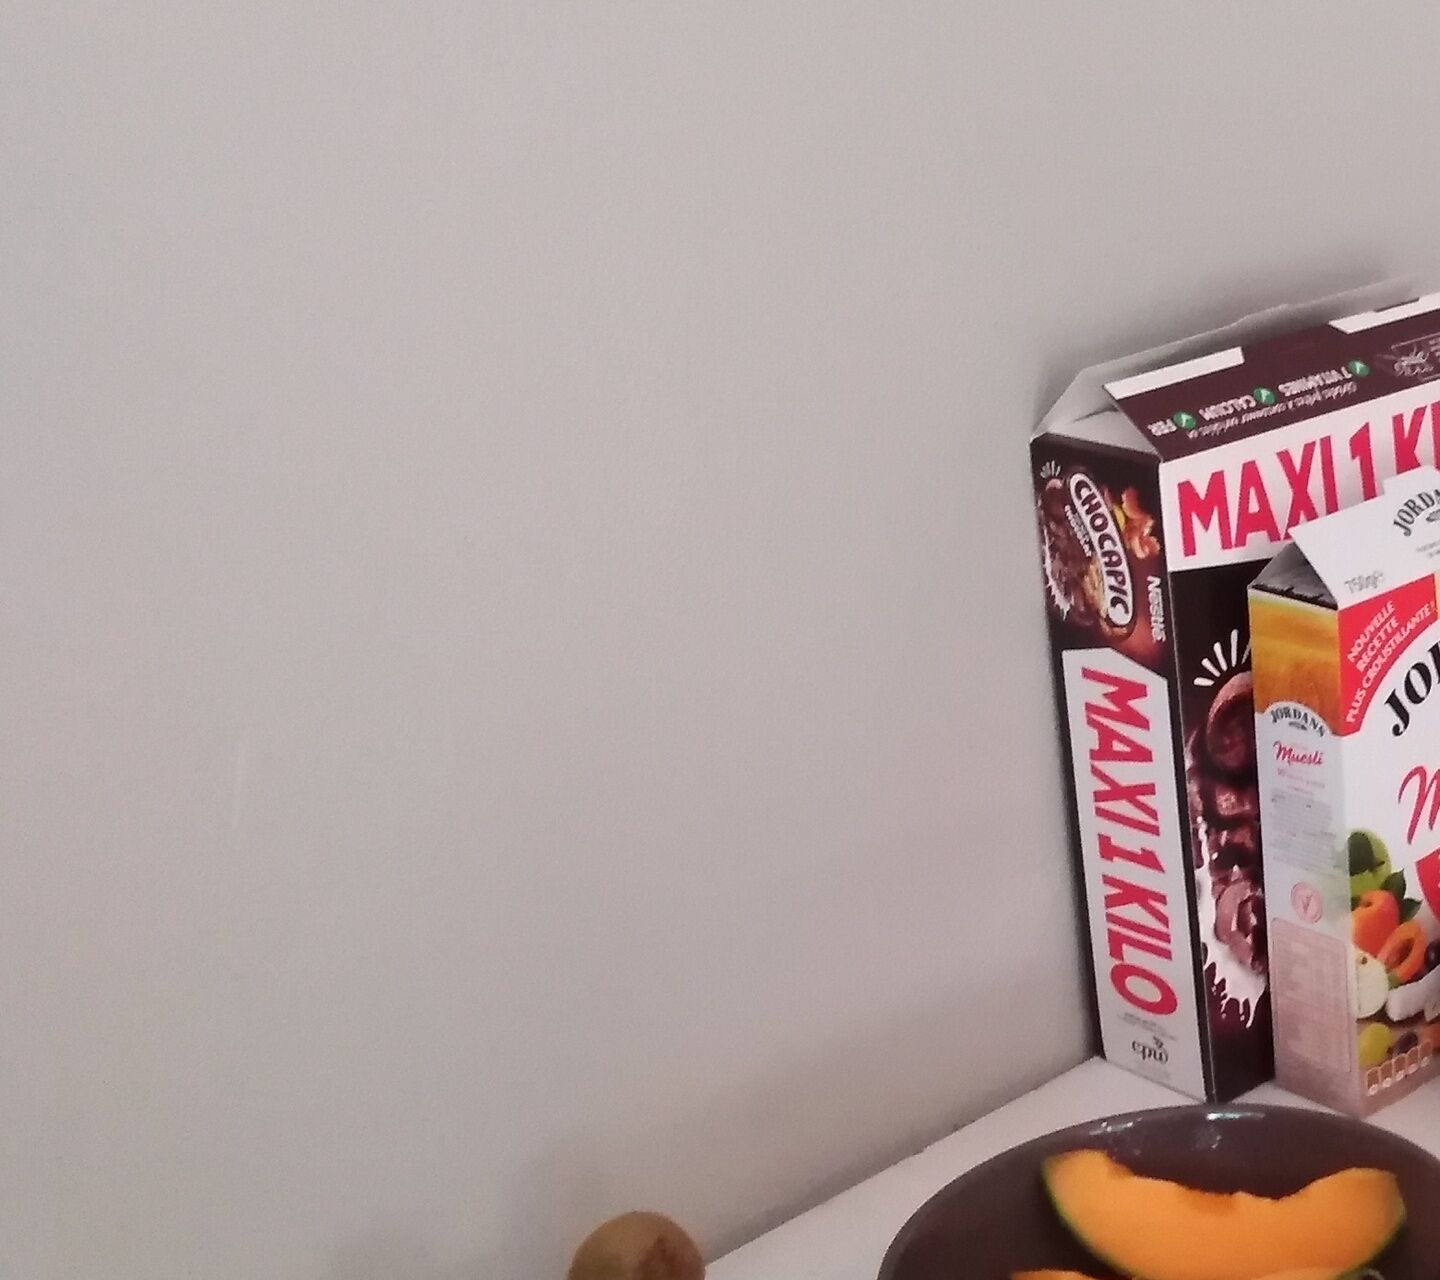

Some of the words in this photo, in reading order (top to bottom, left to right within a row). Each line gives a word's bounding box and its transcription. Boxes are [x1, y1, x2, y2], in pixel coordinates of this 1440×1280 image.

[1177, 435, 1340, 557] MAXI
[1349, 422, 1378, 502] 1
[1073, 480, 1130, 615] CHOCAPIC
[1348, 601, 1395, 662] NOUVELLE
[1356, 615, 1400, 673] RECETTE
[1270, 706, 1326, 737] JORDANS
[1346, 686, 1368, 723] PLUS
[1081, 666, 1161, 837] MAXI
[1273, 740, 1323, 766] Muesli
[1097, 831, 1166, 874] 1
[1101, 873, 1178, 1016] KILO
